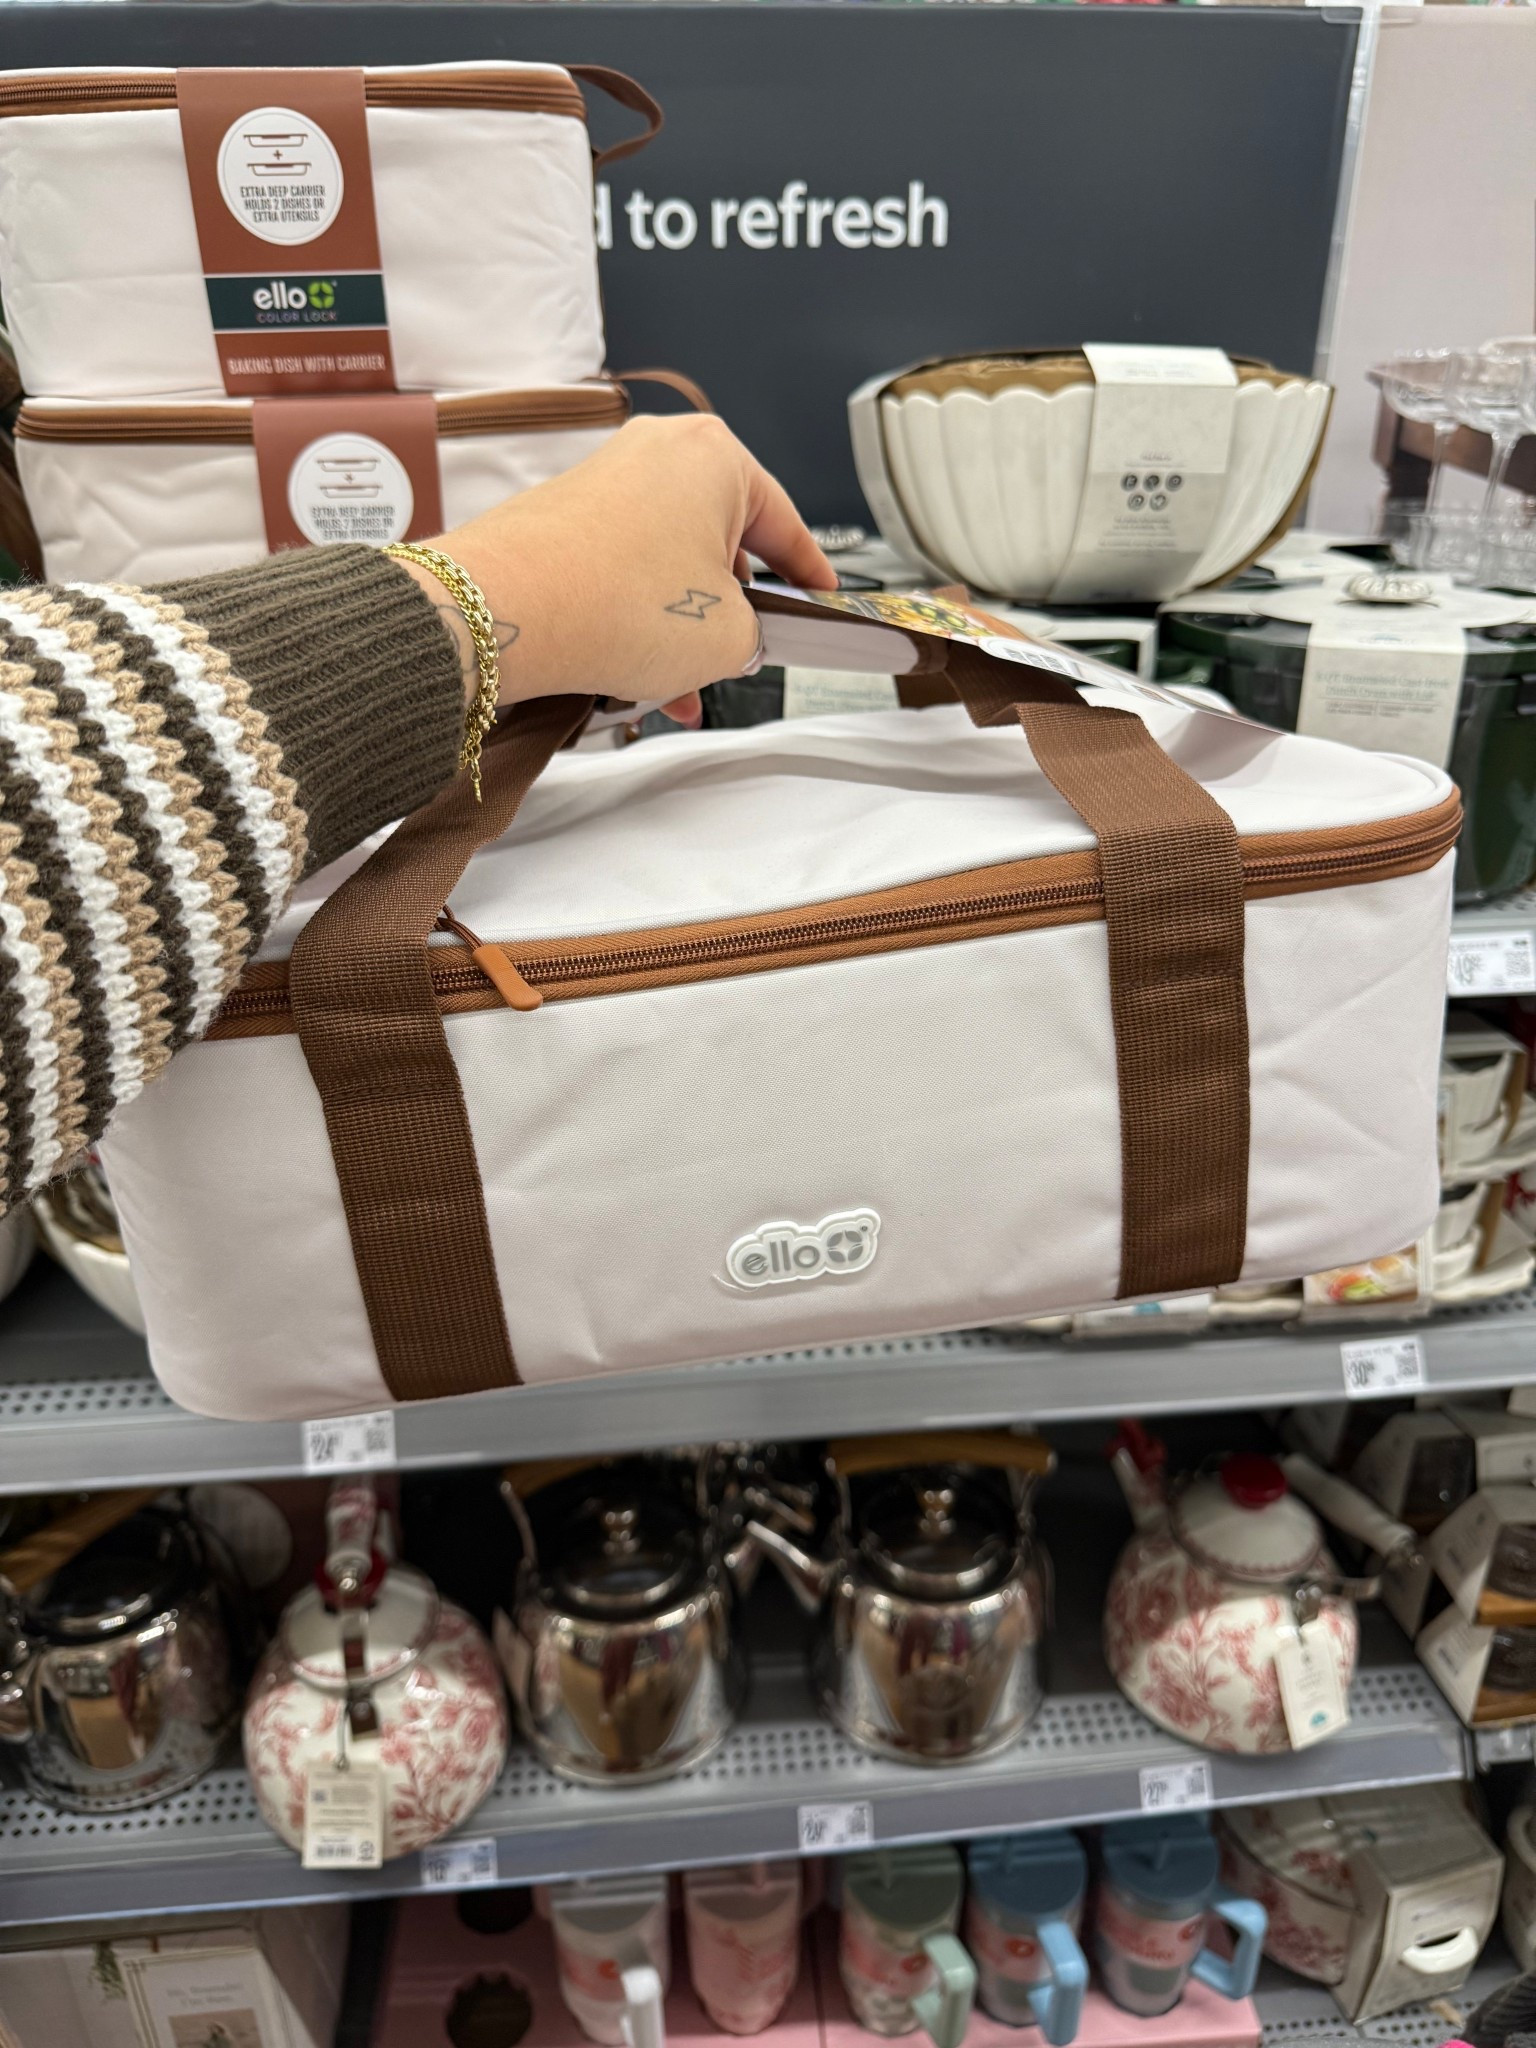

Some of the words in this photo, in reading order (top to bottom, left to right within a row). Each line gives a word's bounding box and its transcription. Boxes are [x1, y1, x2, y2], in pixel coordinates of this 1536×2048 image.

[240, 186, 266, 198] EXTRA
[267, 185, 289, 197] DEEP
[290, 184, 326, 197] CARRIER
[244, 199, 271, 211] HOLDS
[273, 199, 280, 210] 2
[281, 199, 311, 210] DISHES
[313, 198, 325, 209] OR
[253, 211, 279, 223] EXTRA
[280, 210, 321, 222] UTENSILS
[624, 189, 698, 251] to
[710, 179, 950, 250] refresh
[253, 280, 307, 311] ello
[256, 313, 299, 323] COLOR
[304, 311, 337, 322] LOCK
[226, 357, 273, 375] BAKING
[274, 356, 303, 374] DISH
[304, 354, 336, 373] WITH
[336, 353, 386, 372] CARRIER
[741, 1239, 821, 1277] ello
